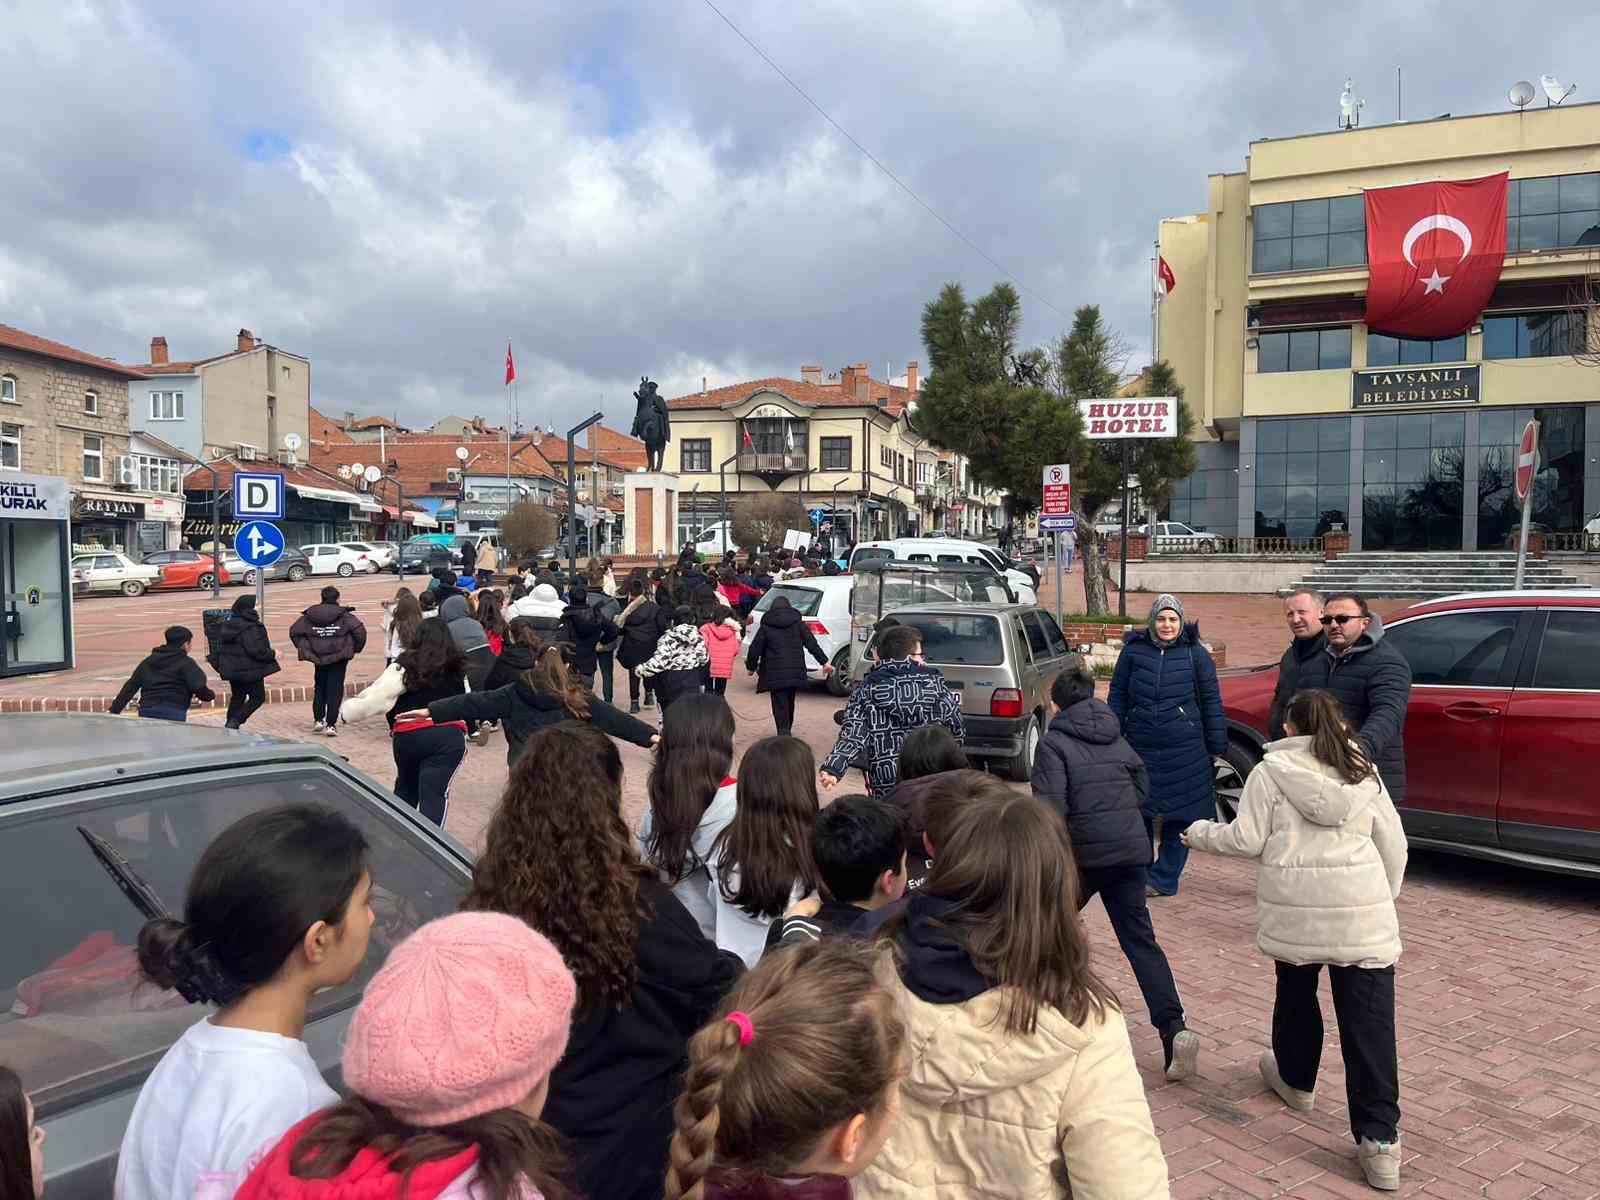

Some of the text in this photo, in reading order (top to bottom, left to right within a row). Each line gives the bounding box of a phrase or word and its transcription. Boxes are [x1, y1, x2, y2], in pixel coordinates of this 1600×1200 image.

[1370, 370, 1461, 387] TAVŞANLI
[1363, 384, 1470, 404] BELEDİYESİ
[1088, 402, 1168, 418] HUZUR
[1090, 419, 1167, 434] HOTEL
[247, 482, 269, 508] D
[87, 500, 136, 513] REYYAN
